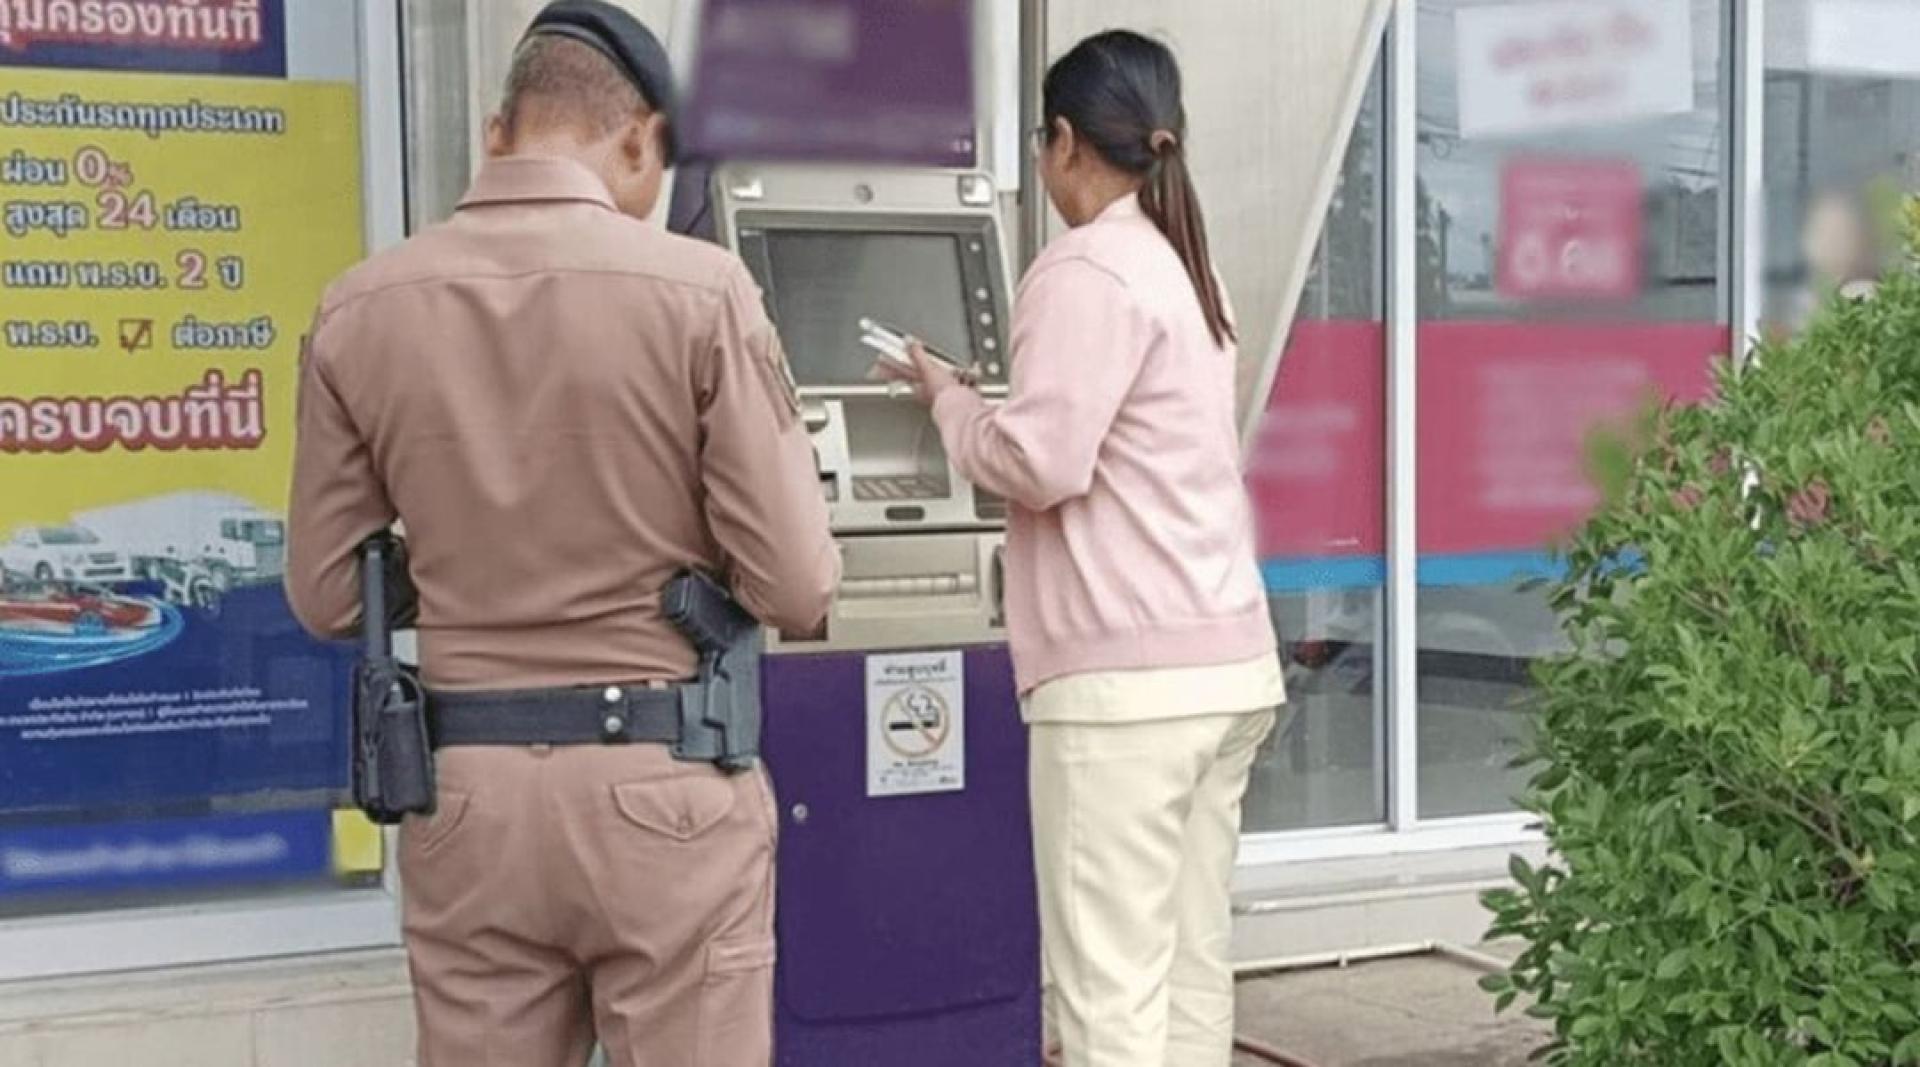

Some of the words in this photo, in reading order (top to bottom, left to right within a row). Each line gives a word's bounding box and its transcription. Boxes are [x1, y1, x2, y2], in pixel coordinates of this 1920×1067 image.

[1, 94, 284, 137] ประกันรถทุกประเภท
[3, 150, 66, 184] ผ่อน
[5, 202, 86, 236] สูงสุด
[98, 191, 156, 229] 24
[163, 198, 239, 230] เดือน
[4, 262, 68, 287] แถม
[77, 262, 167, 287] พ.ร.บ.
[178, 251, 206, 287] 2
[216, 256, 243, 288] ปี
[5, 322, 97, 347] พ.ร.บ.
[173, 315, 273, 347] ต่อภาษี
[0, 371, 263, 442] ครบจบที่นี่
